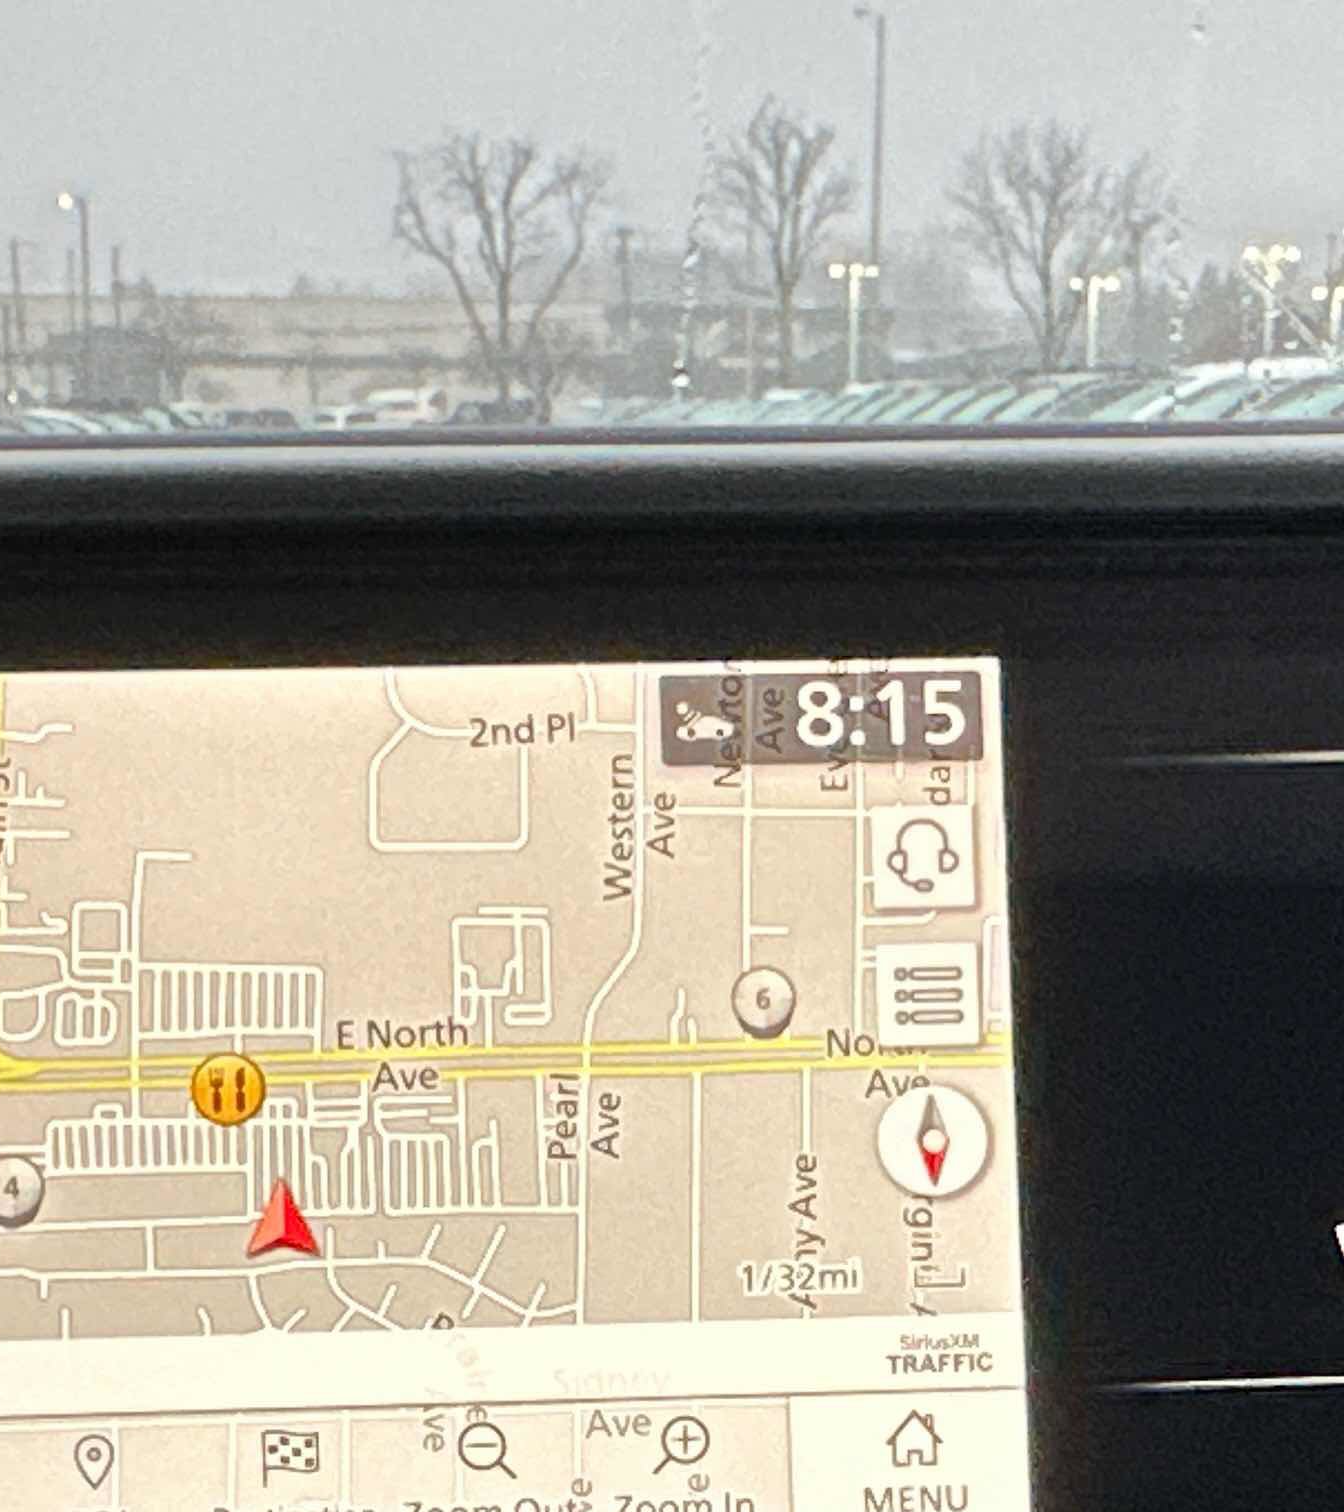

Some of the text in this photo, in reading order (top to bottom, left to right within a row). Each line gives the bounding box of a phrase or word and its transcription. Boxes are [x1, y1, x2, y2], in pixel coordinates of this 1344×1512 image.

[470, 714, 575, 746] 2nd Pl
[754, 688, 785, 752] Ave
[796, 679, 965, 747] 8:15
[603, 754, 634, 901] Western
[646, 792, 676, 859] Ave
[756, 988, 771, 1010] 6
[337, 1017, 468, 1050] E North
[372, 1062, 439, 1092] Ave
[547, 1073, 579, 1159] Pearl
[590, 1092, 621, 1159] Ave
[5, 1176, 20, 1198] 4
[789, 1154, 817, 1220] Ave
[886, 1353, 992, 1374] TRAFFIC
[586, 1410, 653, 1438] Ave
